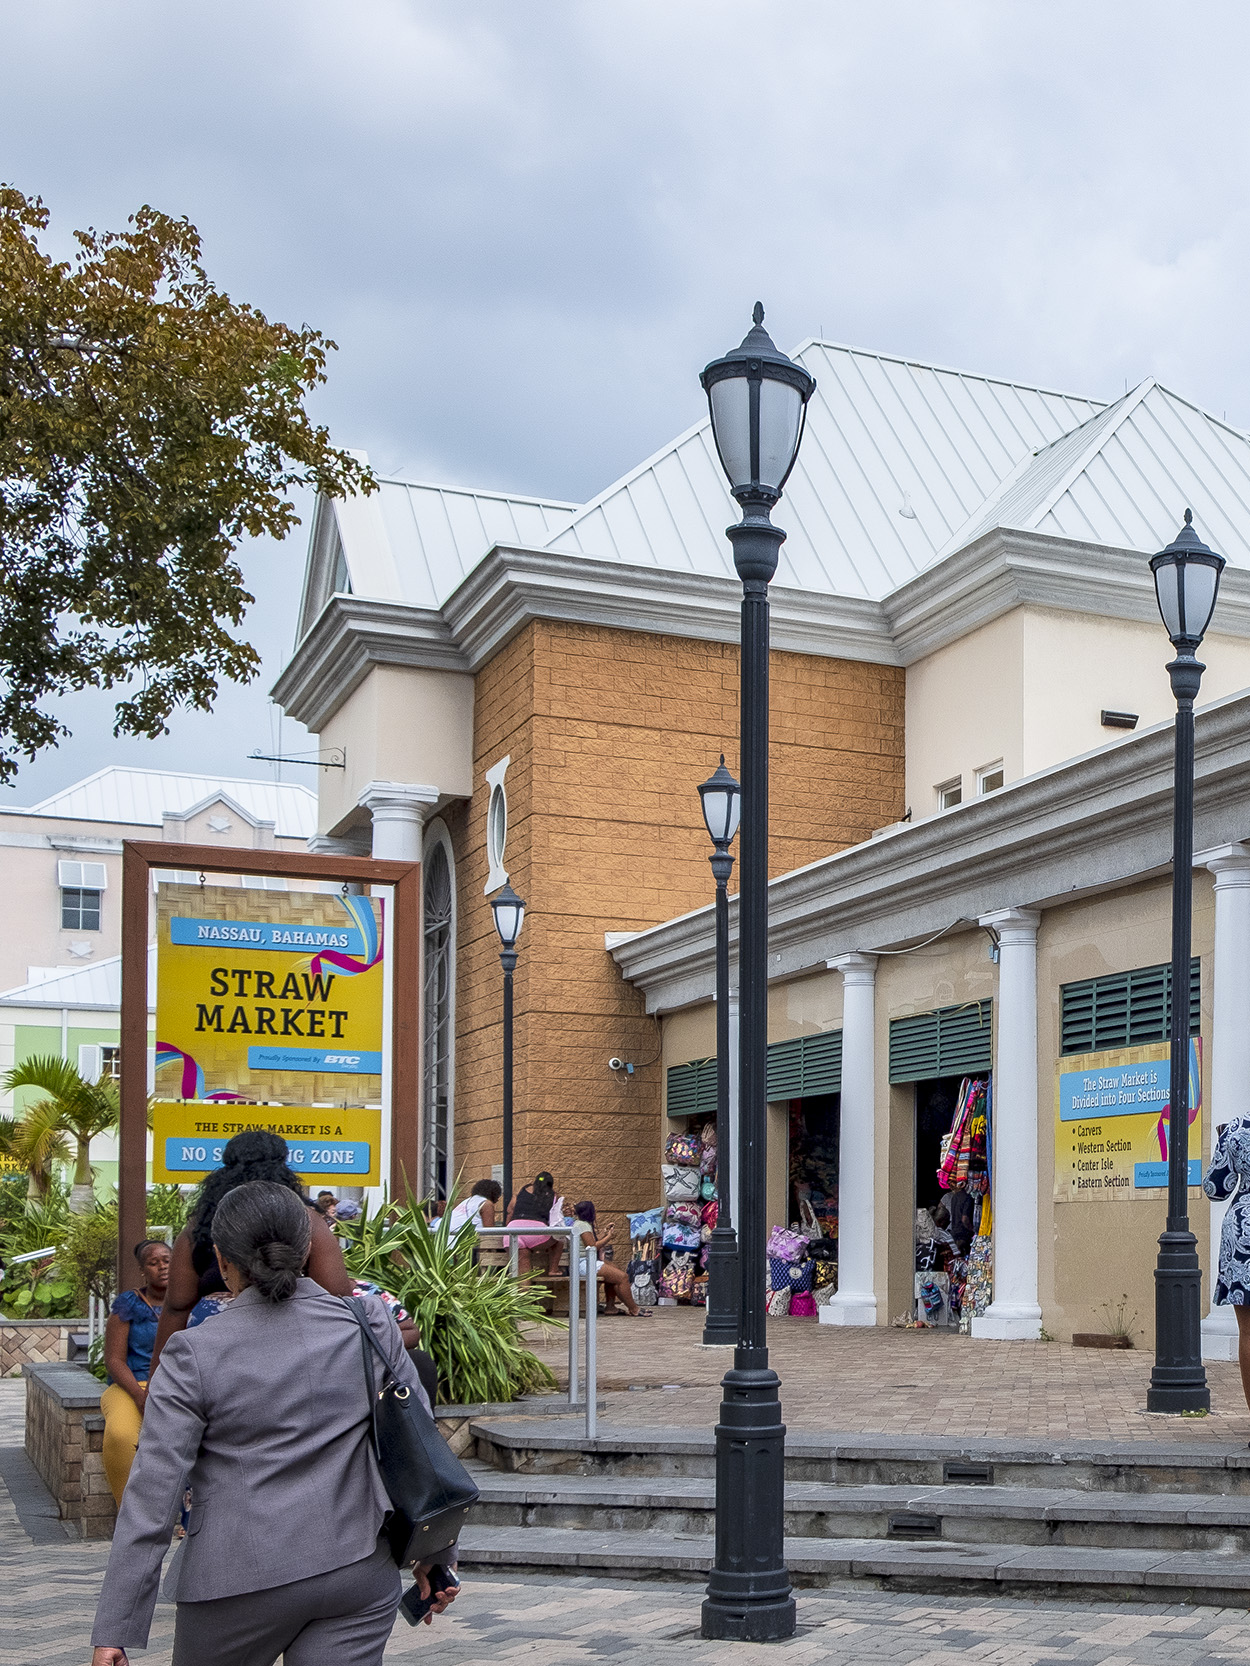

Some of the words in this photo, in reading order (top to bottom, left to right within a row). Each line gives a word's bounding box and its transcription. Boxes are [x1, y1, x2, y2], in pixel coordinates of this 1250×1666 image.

[197, 925, 266, 944] NASSAU,
[271, 930, 349, 948] BAHAMAS
[210, 967, 335, 1002] STRAW
[194, 1003, 348, 1038] MARKET
[323, 1055, 360, 1065] BTC
[1083, 1077, 1097, 1092] The
[1098, 1076, 1120, 1090] Straw
[1121, 1071, 1148, 1087] Market
[1150, 1069, 1158, 1084] is
[1072, 1092, 1099, 1110] Divided
[1101, 1091, 1117, 1106] into
[1118, 1089, 1136, 1105] Four
[1137, 1086, 1170, 1103] Sections
[195, 1122, 219, 1133] THE
[222, 1123, 265, 1133] STRAW
[267, 1124, 315, 1135] MARKET
[319, 1125, 331, 1136] IS
[334, 1126, 343, 1136] A
[1077, 1125, 1102, 1137] Carvers
[1077, 1142, 1105, 1154] Western
[1106, 1139, 1132, 1153] Section
[181, 1147, 207, 1162] NO
[310, 1150, 354, 1165] ZONE
[1077, 1159, 1099, 1172] Center
[1101, 1157, 1114, 1170] Isle
[1077, 1176, 1103, 1189] Eastern
[1104, 1174, 1130, 1187] Section
